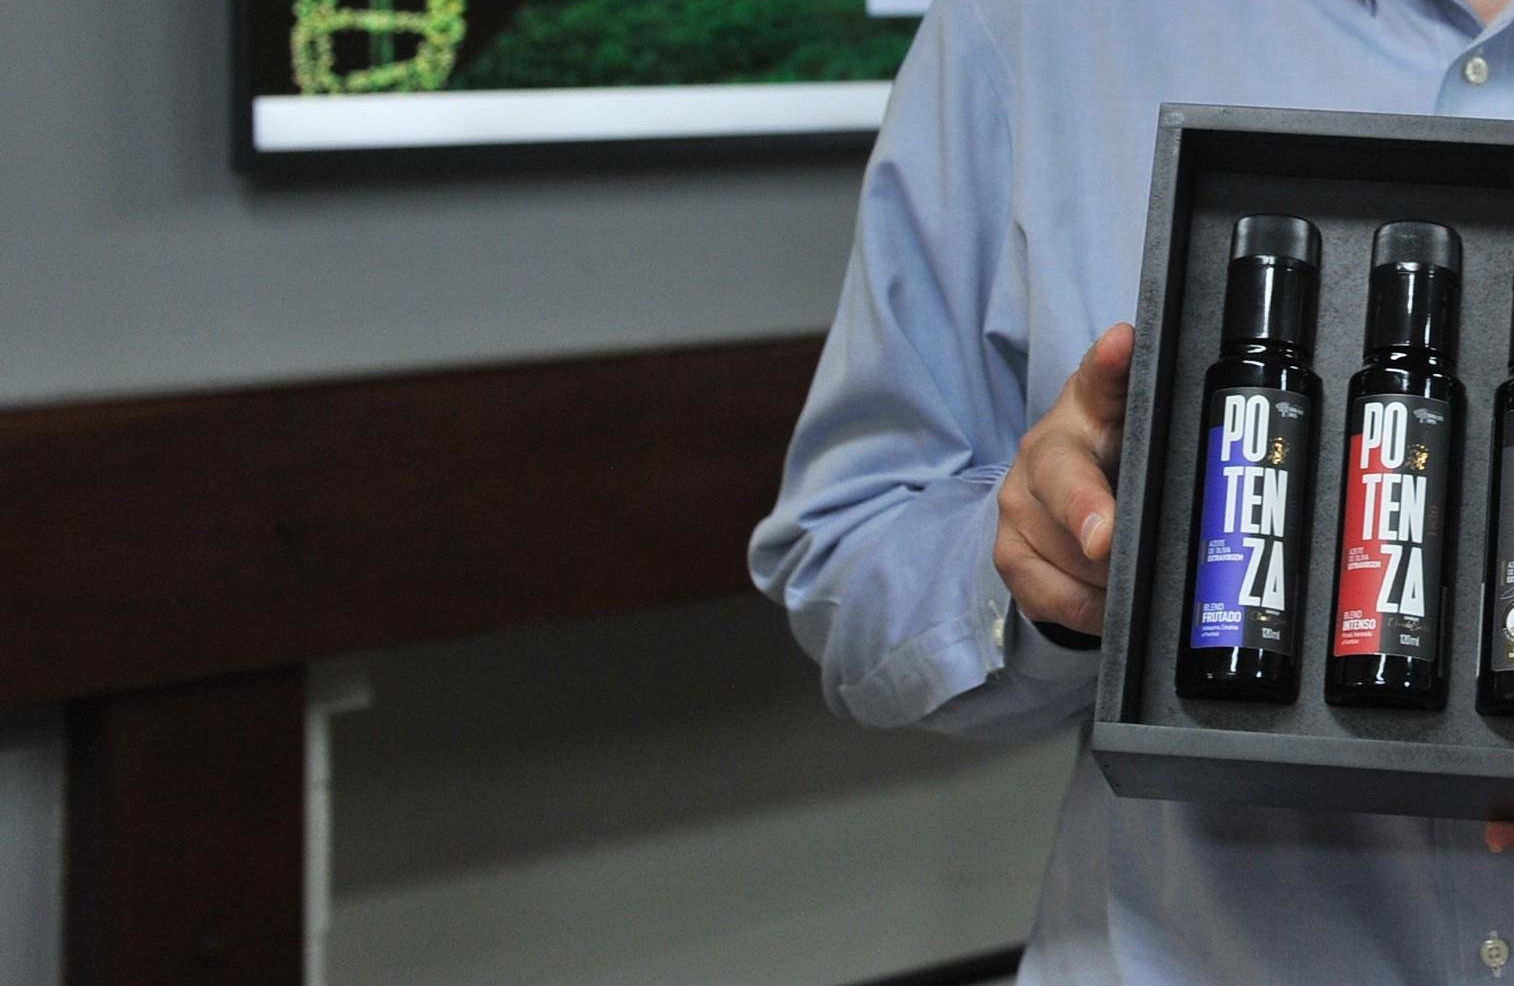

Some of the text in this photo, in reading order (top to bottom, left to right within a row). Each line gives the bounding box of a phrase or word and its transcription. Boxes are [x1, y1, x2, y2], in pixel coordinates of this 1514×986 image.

[1221, 395, 1270, 463] PO
[1360, 401, 1408, 469] PO
[1223, 466, 1289, 538] TEN
[1362, 473, 1427, 544] TEN
[1238, 537, 1285, 611] ZA
[1376, 544, 1425, 618] ZA
[1202, 611, 1241, 623] FRUTADO
[1342, 619, 1376, 631] INTENSO
